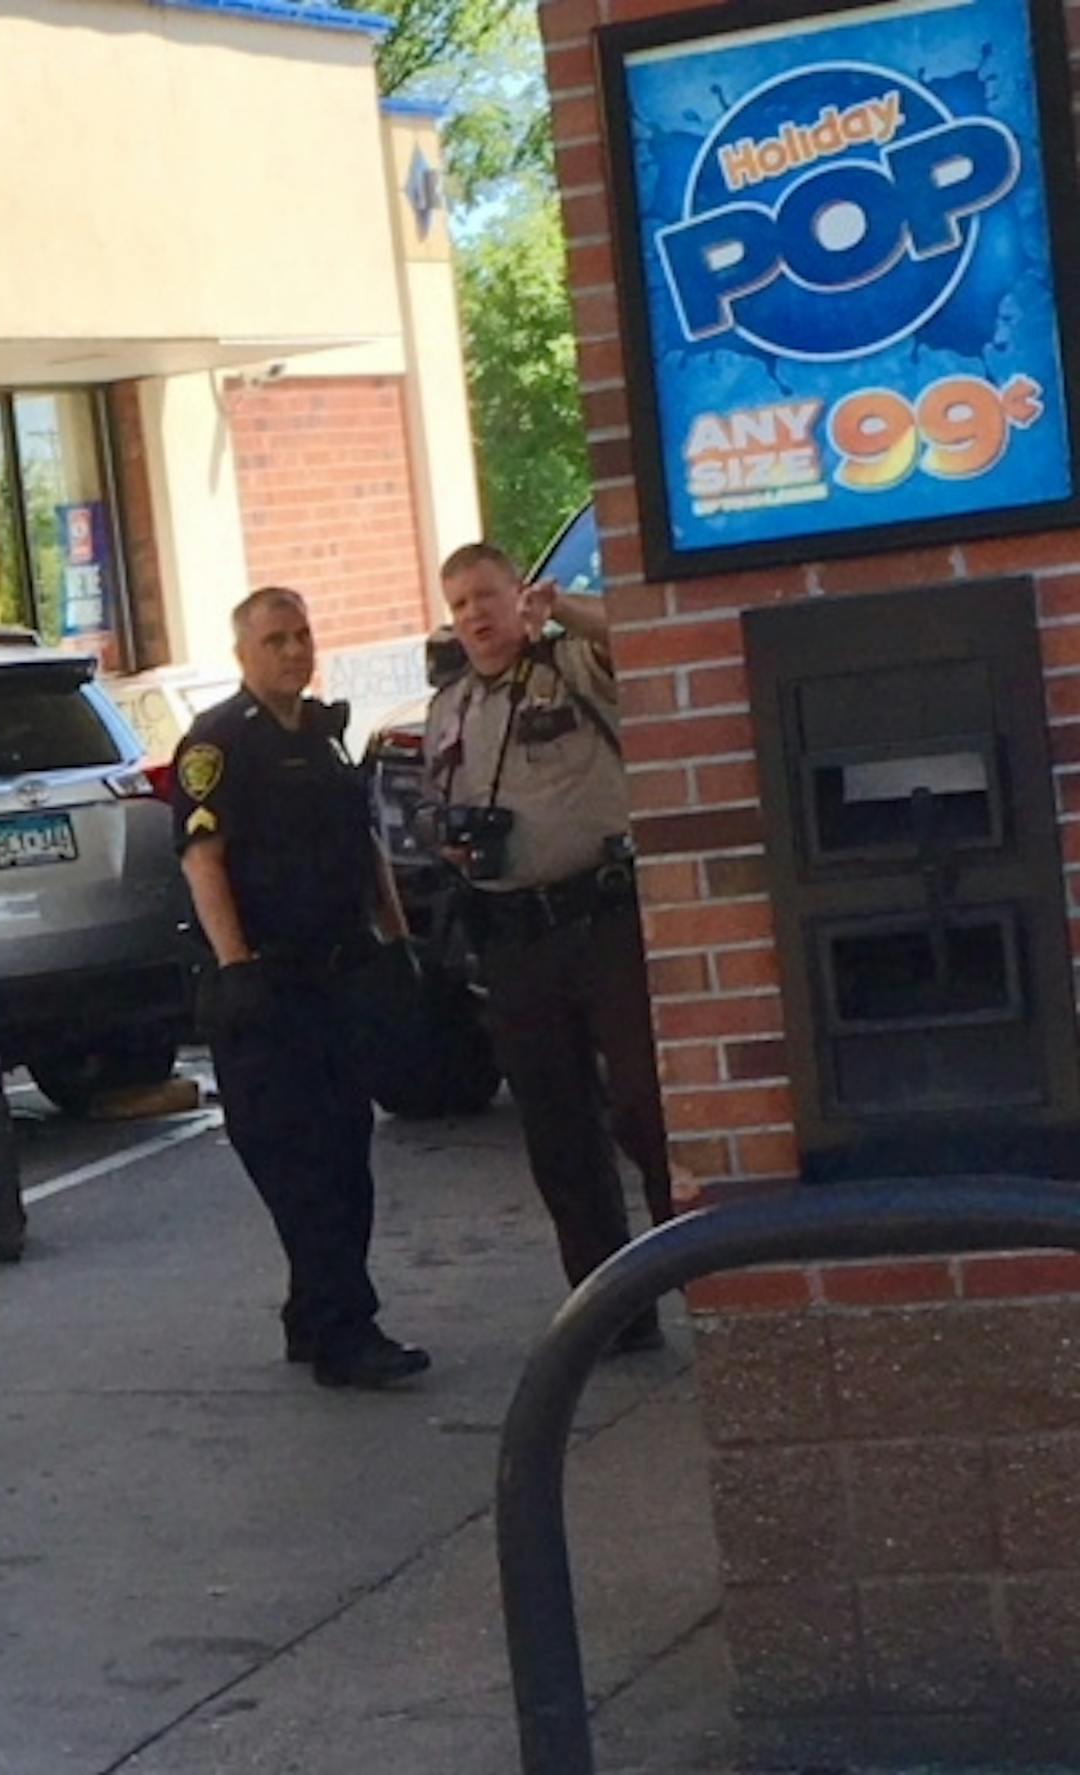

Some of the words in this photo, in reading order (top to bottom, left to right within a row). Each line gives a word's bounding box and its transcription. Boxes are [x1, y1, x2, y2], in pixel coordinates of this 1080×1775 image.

[720, 91, 905, 190] Holiday
[655, 117, 1020, 342] POP
[685, 401, 822, 459] ANY
[687, 450, 820, 495] SIZE
